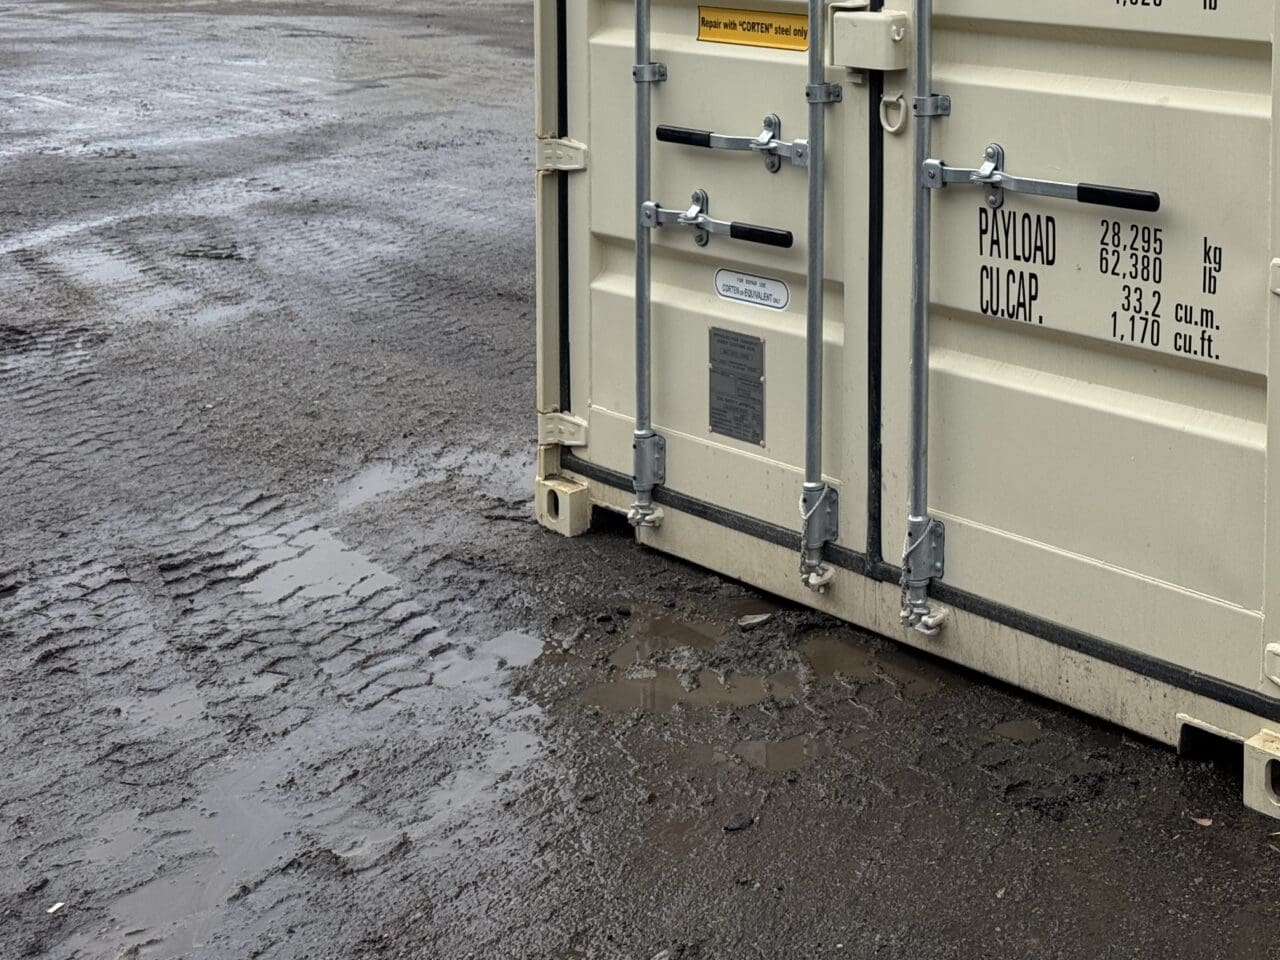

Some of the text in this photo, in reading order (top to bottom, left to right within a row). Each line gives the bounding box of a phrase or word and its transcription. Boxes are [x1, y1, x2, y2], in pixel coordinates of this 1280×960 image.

[701, 16, 721, 31] Repair
[723, 20, 738, 31] with
[774, 25, 792, 36] steel
[793, 26, 808, 40] only
[979, 207, 1222, 273] PAYLOAD 28,295 kg
[1100, 248, 1217, 295] 62,380 lb
[980, 265, 1220, 330] CU.CAP. 33.2 cu.m.
[1111, 311, 1220, 360] 1,170 cu.ft.
